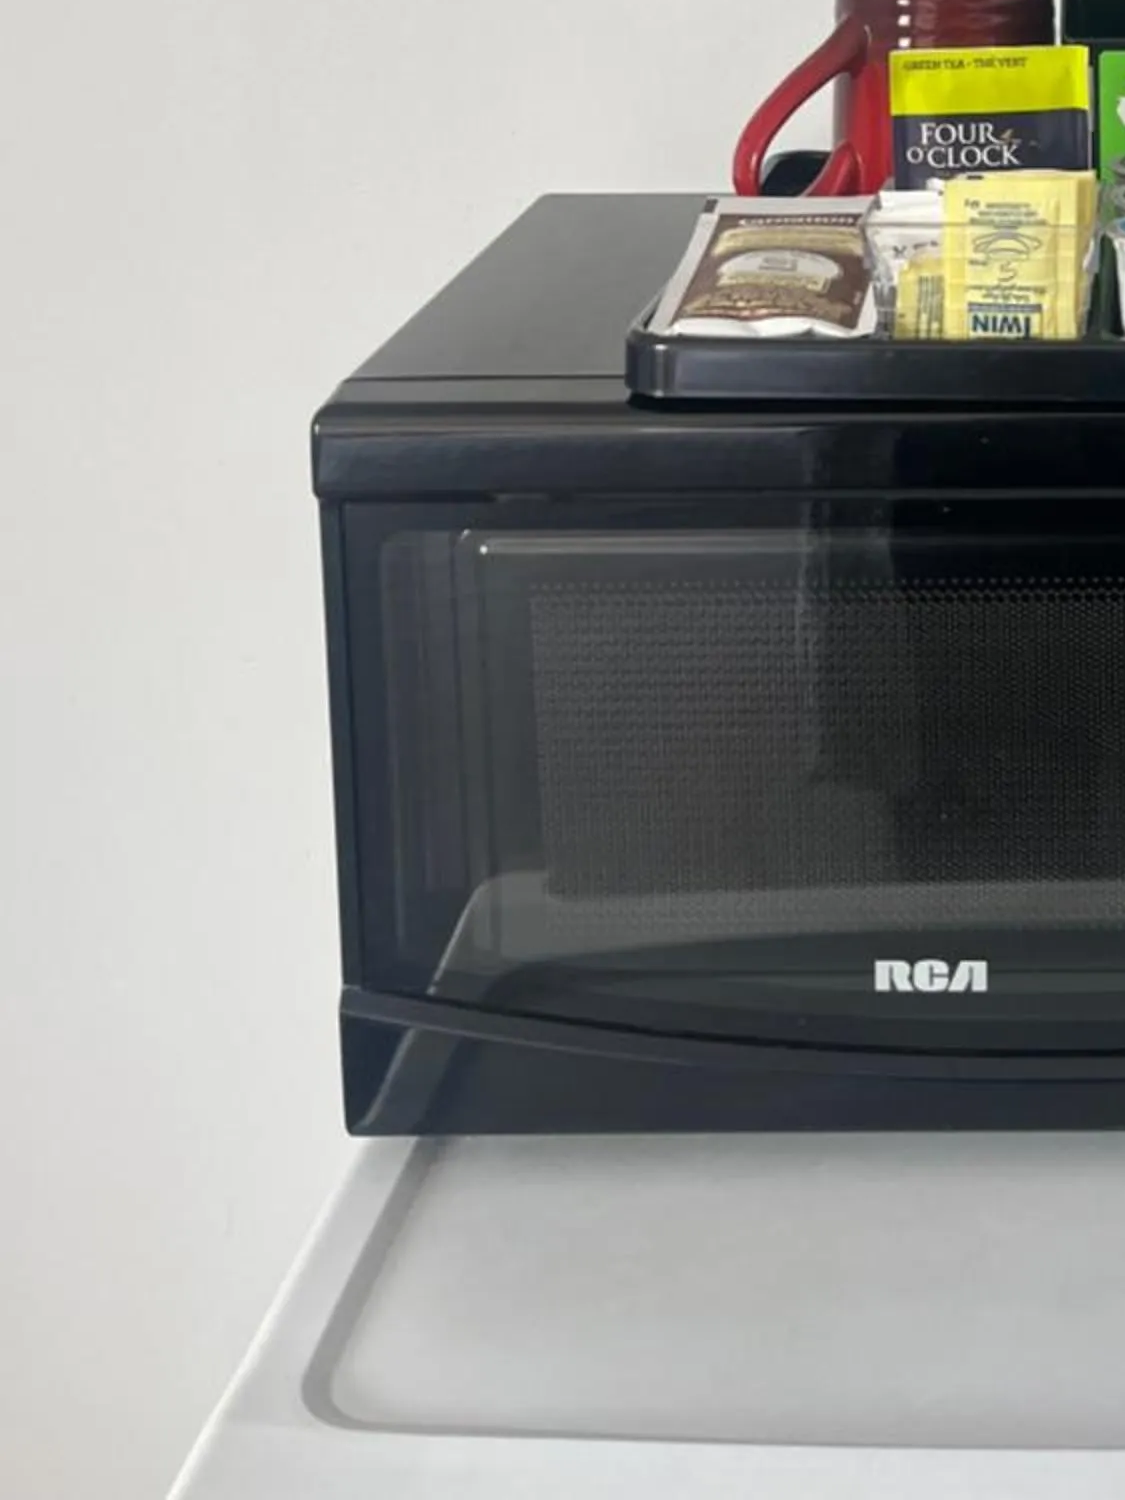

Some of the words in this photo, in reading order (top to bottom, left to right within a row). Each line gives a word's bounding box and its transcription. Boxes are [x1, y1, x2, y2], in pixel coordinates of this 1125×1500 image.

[941, 59, 965, 70] TEA
[997, 56, 1029, 69] VERT
[920, 122, 1001, 146] FOUR
[874, 959, 988, 992] RCA
